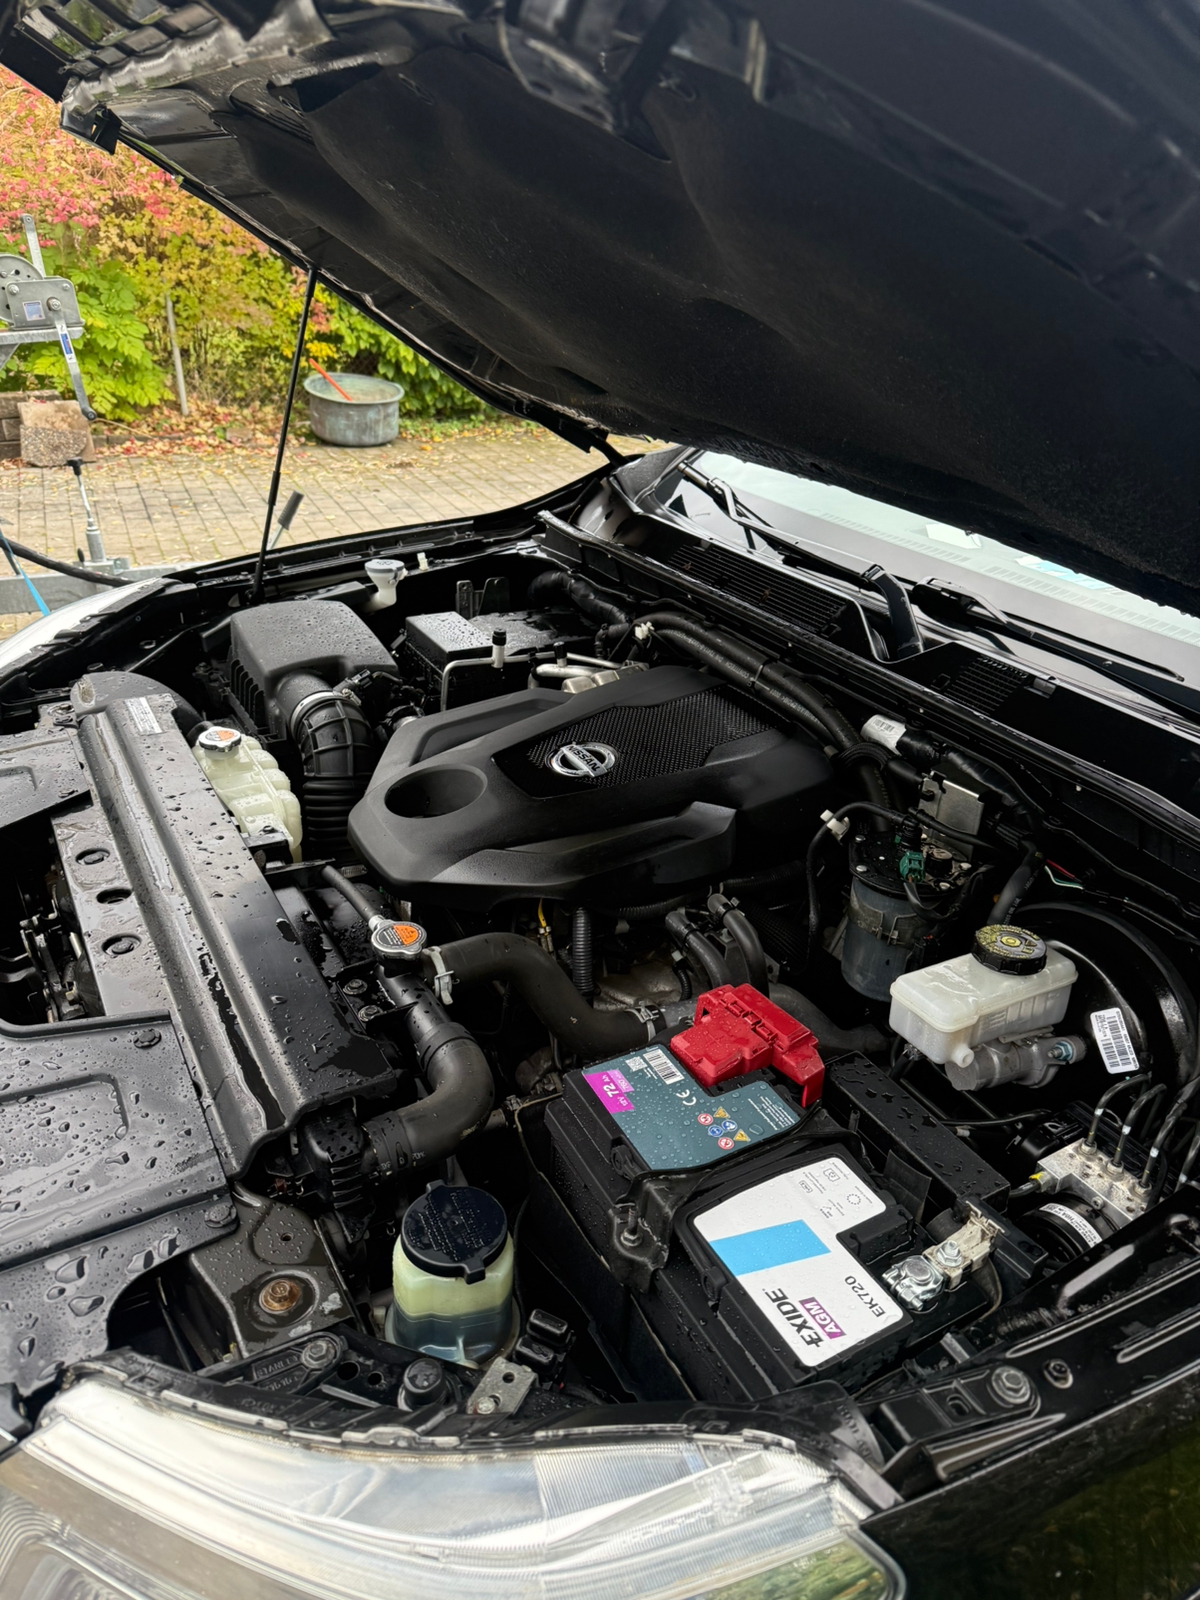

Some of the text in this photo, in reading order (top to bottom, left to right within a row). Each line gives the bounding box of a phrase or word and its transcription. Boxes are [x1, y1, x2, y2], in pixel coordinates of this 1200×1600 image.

[568, 745, 601, 771] NISSAN
[603, 1083, 619, 1098] 72
[676, 1089, 697, 1106] CE
[845, 1275, 886, 1317] EK720
[764, 1288, 824, 1347] EXIDE
[803, 1300, 842, 1335] AGM
